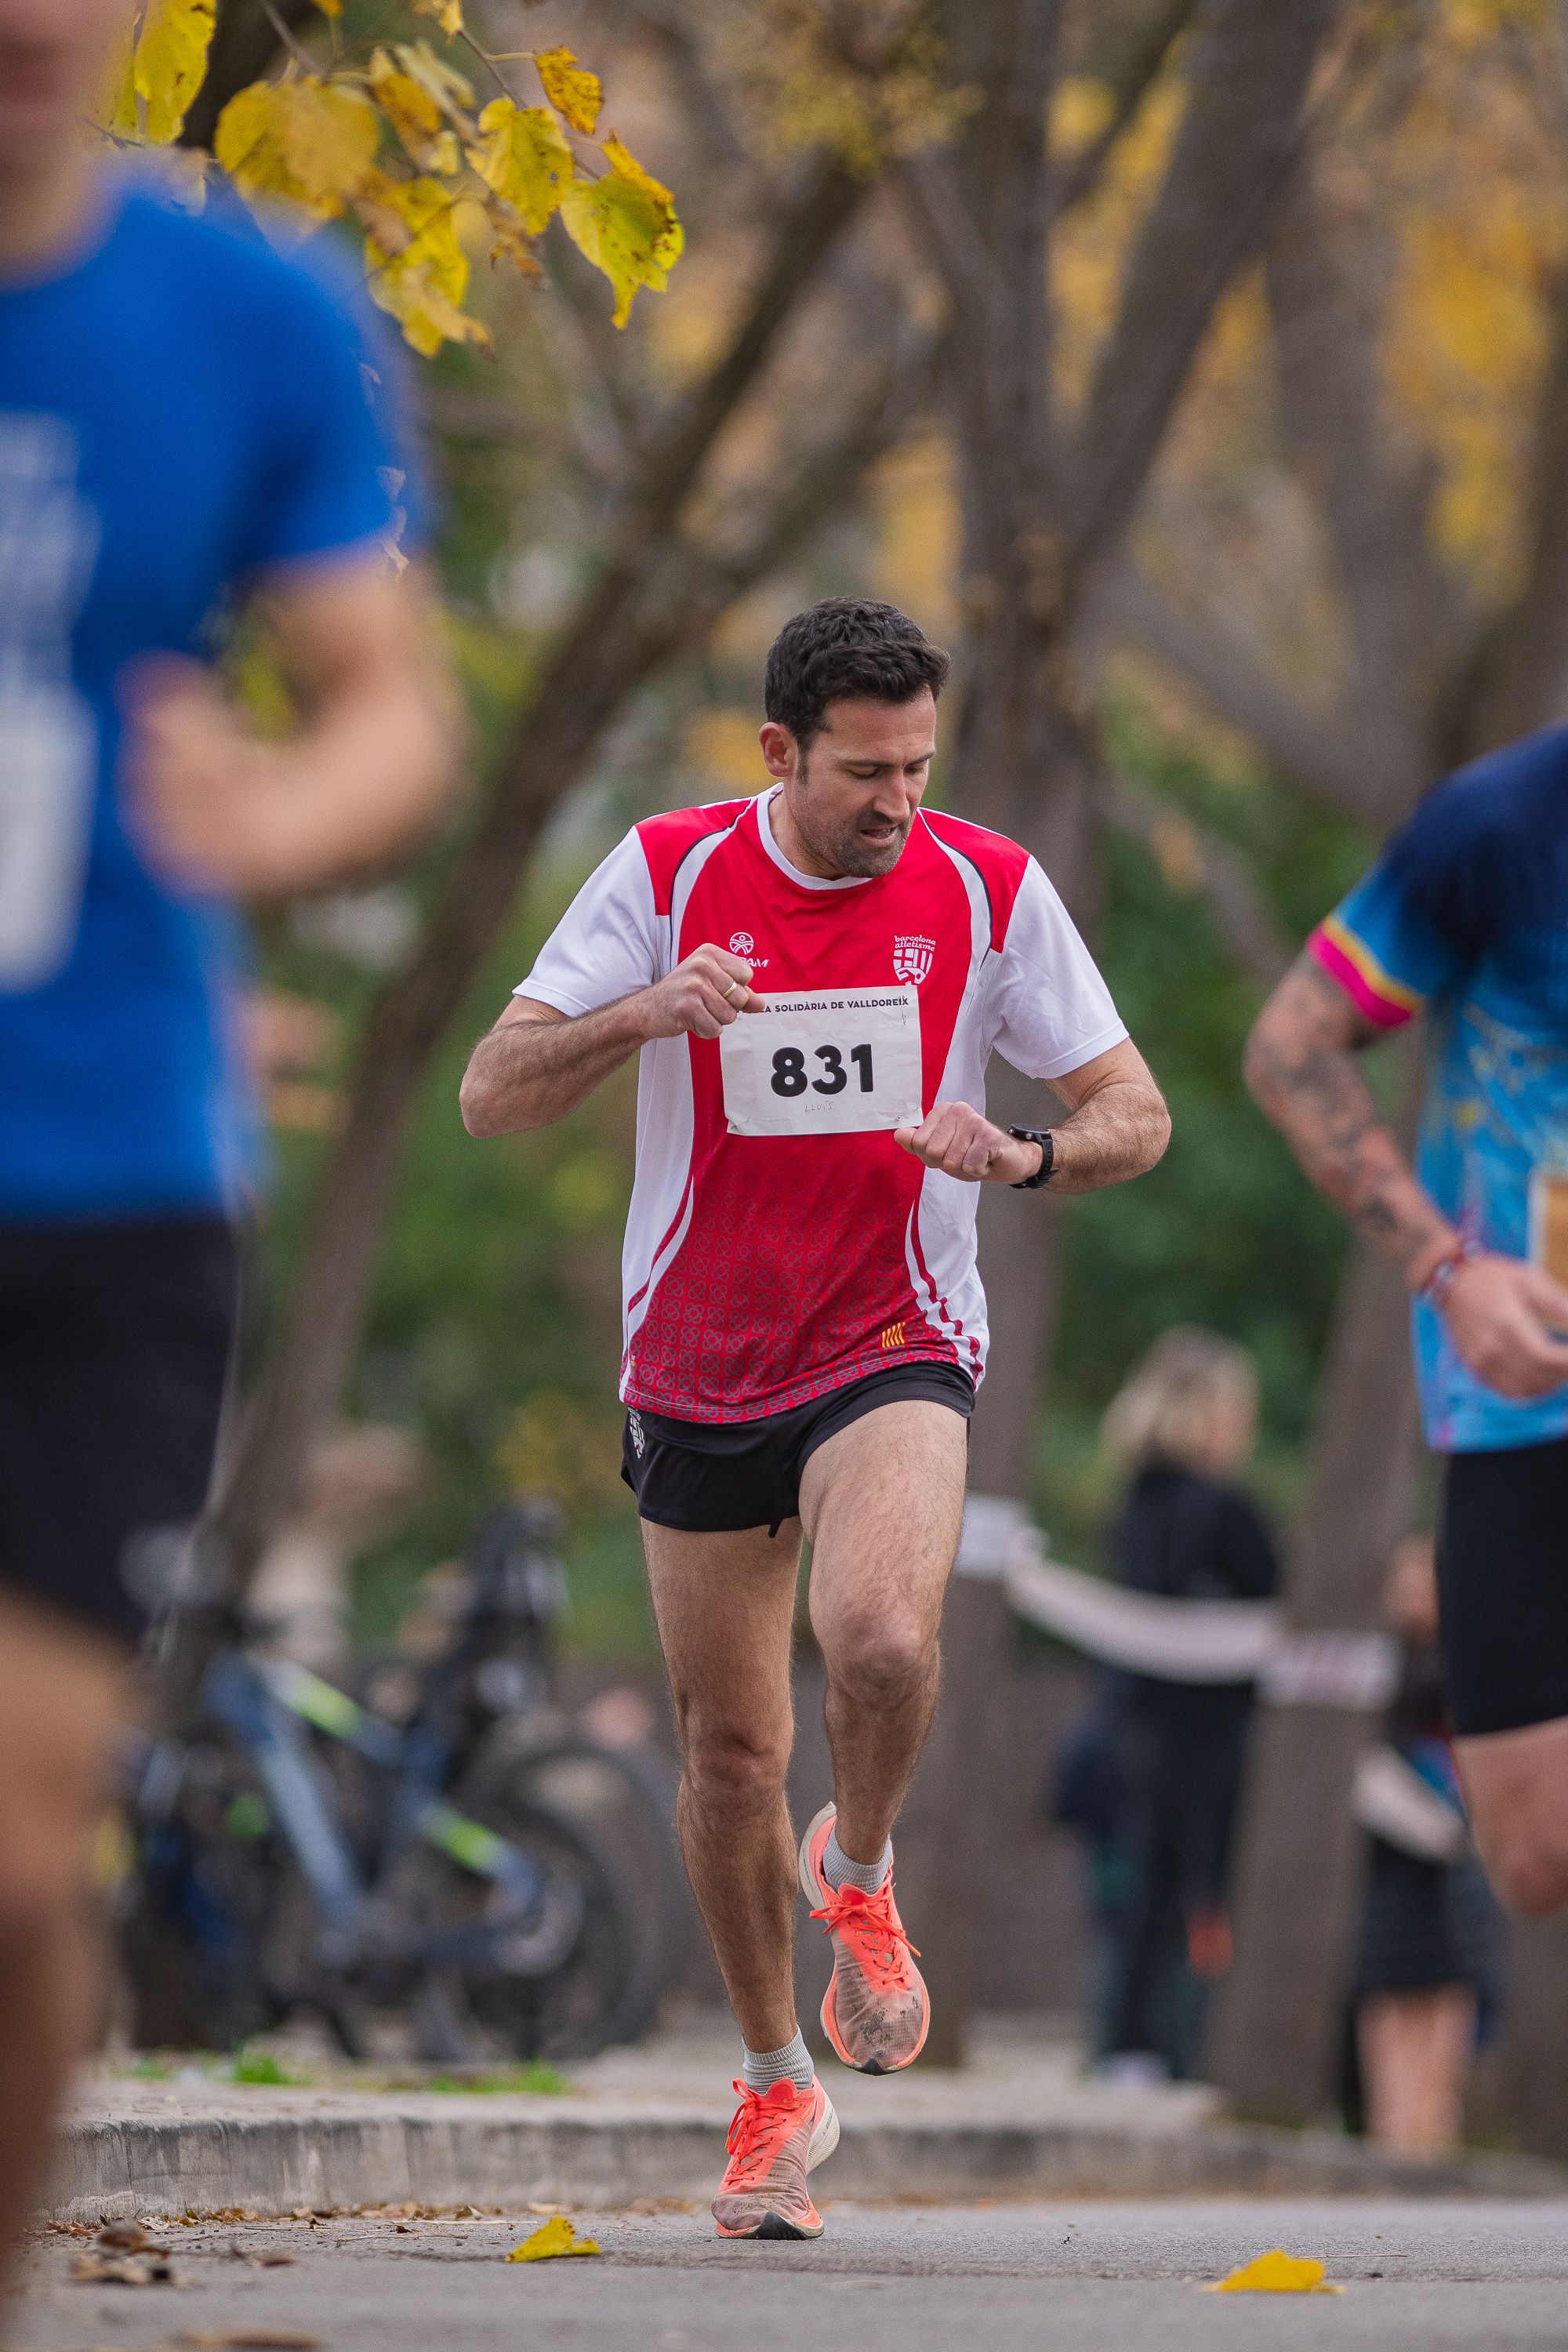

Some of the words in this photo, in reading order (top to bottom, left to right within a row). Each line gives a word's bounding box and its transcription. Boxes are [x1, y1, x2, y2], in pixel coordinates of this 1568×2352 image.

[894, 934, 936, 946] barcelona
[895, 941, 935, 952] atletisme
[775, 1001, 827, 1012] SOLIDÀRIA
[847, 996, 909, 1008] VALLDOREIX
[771, 1044, 874, 1098] 831
